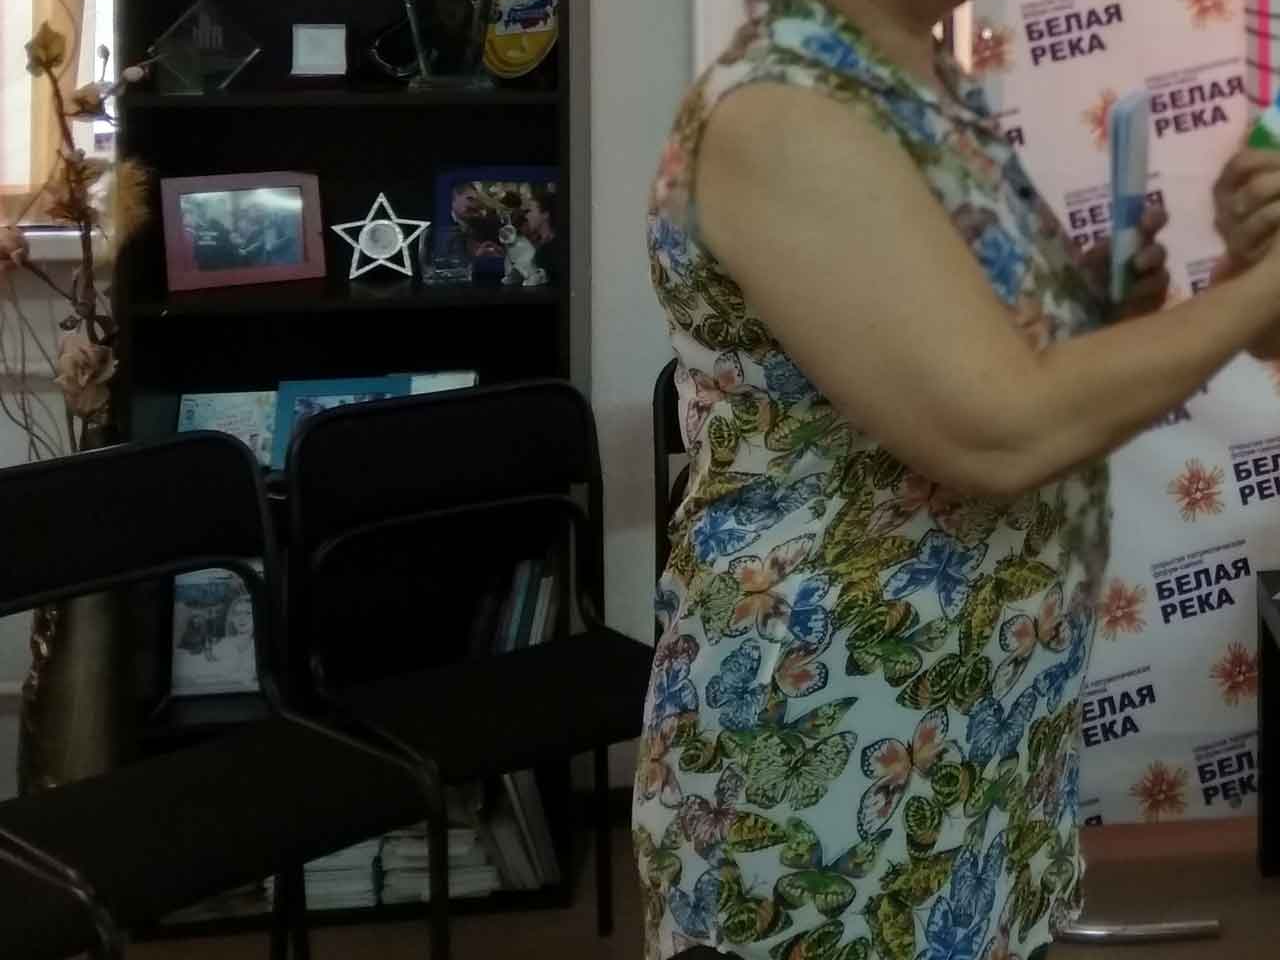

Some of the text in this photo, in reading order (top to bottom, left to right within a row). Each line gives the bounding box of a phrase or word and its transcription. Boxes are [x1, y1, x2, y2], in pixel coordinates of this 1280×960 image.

[1025, 3, 1124, 43] БЕЛАЯ
[1030, 33, 1107, 67] РЕКА
[1150, 76, 1246, 115] БЕЛАЯ
[1155, 105, 1228, 140] РЕКА
[1156, 557, 1251, 601] БЕЛАЯ
[1161, 588, 1235, 624] РЕКА
[1082, 684, 1156, 723] ЕЛАЯ
[1082, 715, 1139, 747] ЕКА
[1198, 751, 1255, 784] БЕЛ
[1203, 773, 1257, 806] РЕК
